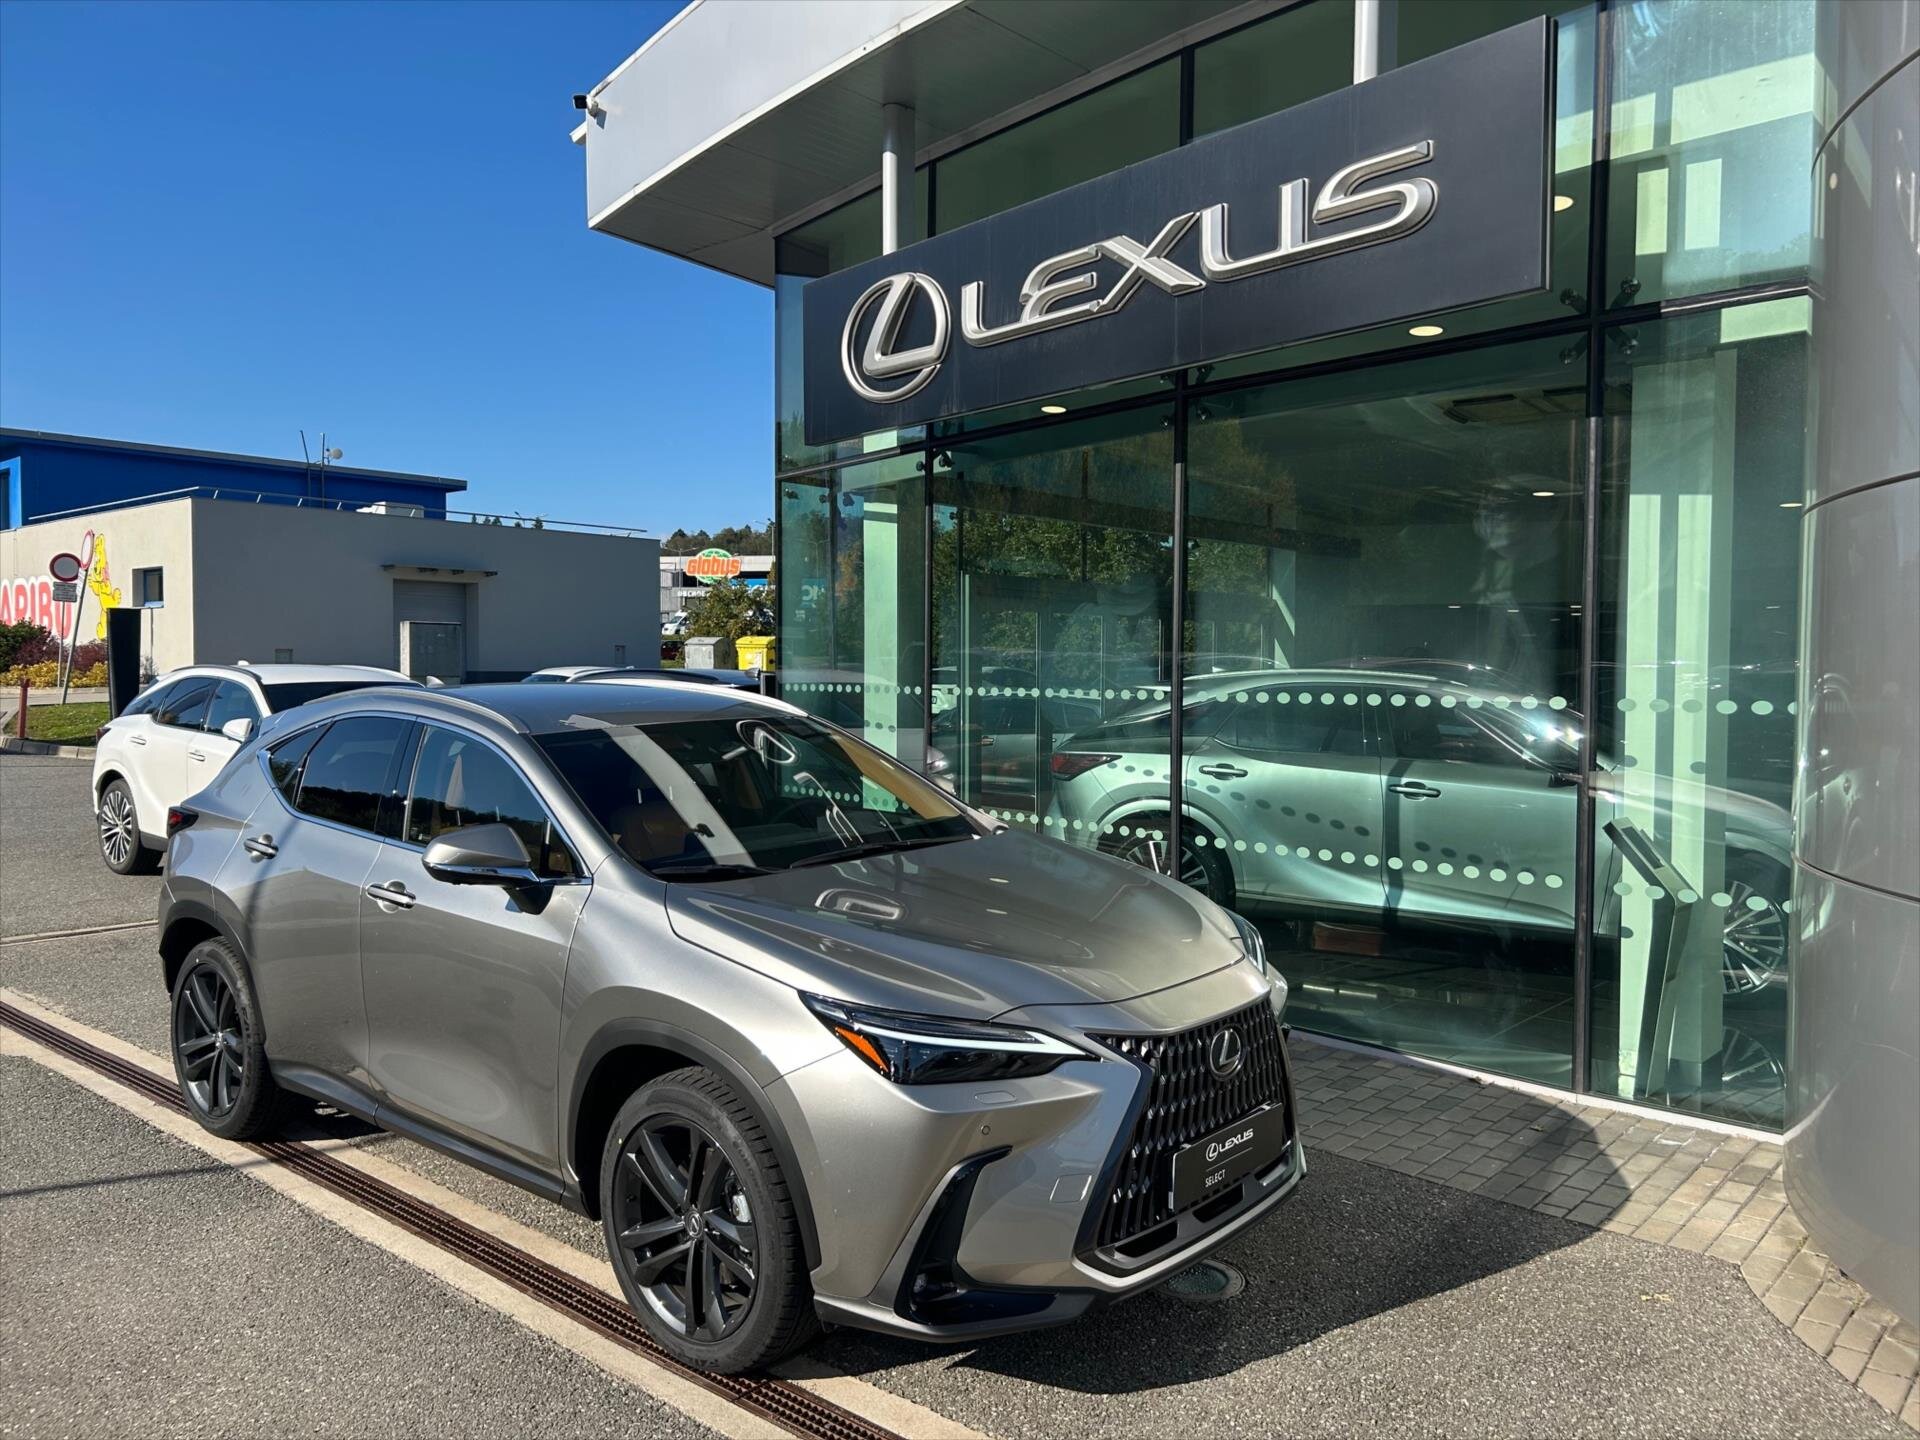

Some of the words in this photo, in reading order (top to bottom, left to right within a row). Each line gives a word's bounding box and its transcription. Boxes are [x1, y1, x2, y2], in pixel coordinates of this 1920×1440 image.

[961, 139, 1438, 348] LEXUS
[1219, 1129, 1254, 1152] LEXUS
[1205, 1169, 1226, 1188] SELECT
